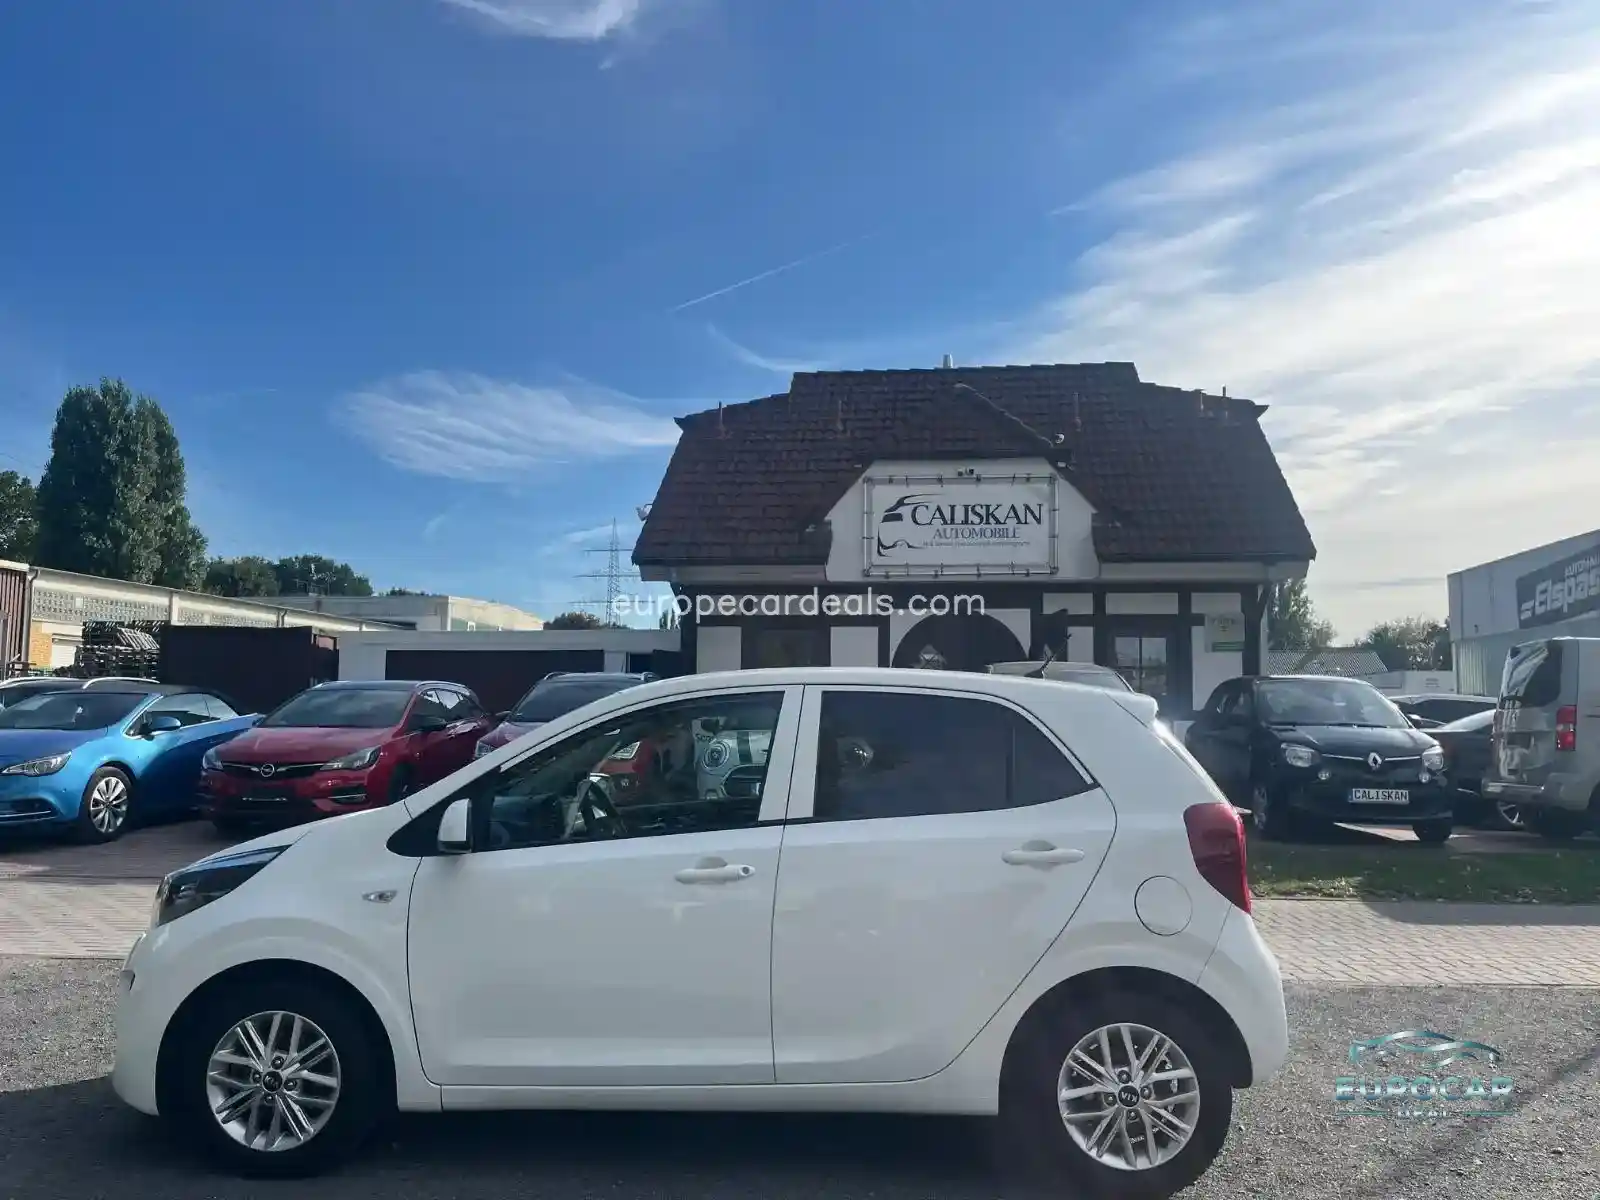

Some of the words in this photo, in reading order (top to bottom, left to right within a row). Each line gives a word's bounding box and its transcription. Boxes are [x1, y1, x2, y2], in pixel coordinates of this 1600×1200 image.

[911, 503, 1043, 526] CALISKAN
[933, 526, 1020, 540] AUTOMOBILE
[1354, 790, 1408, 801] CALISKAN
